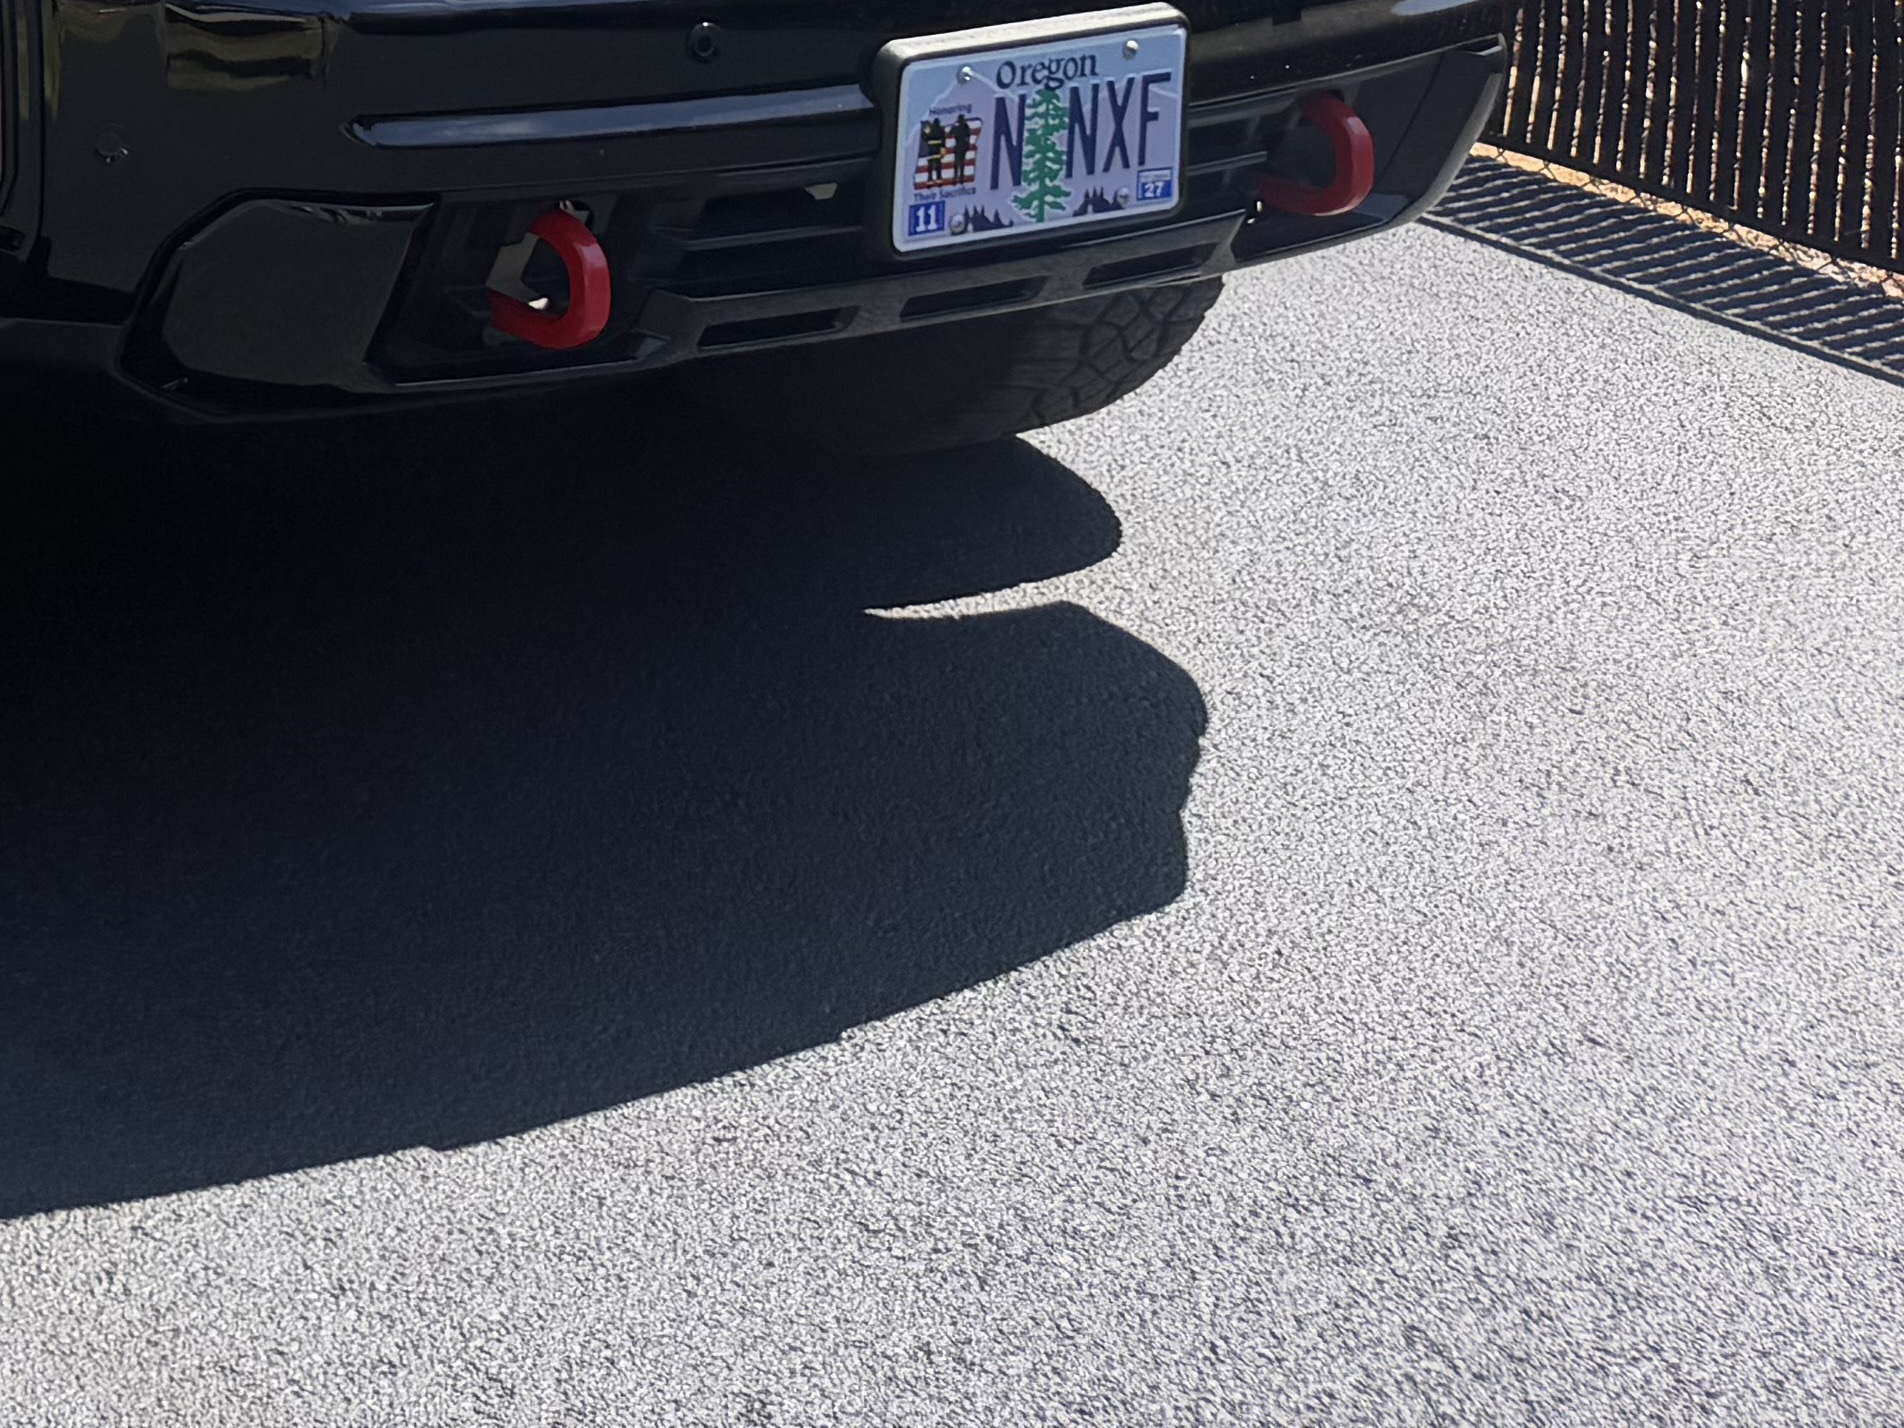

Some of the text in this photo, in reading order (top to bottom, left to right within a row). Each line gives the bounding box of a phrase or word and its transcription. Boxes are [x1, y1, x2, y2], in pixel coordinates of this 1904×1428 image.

[996, 54, 1099, 89] Oregon
[990, 71, 1172, 191] N NXF
[1144, 181, 1165, 198] 27
[915, 204, 938, 233] 11
